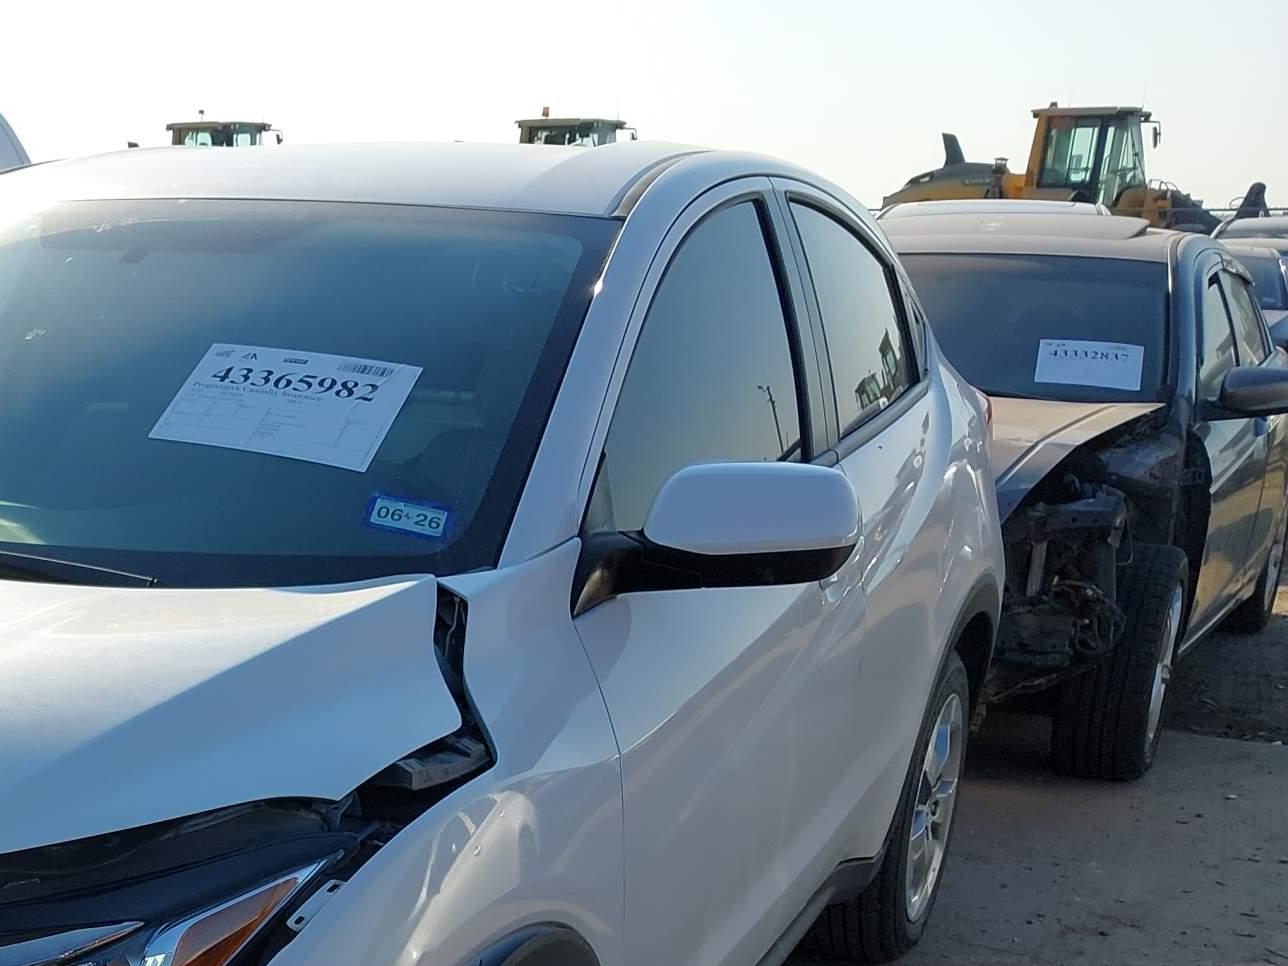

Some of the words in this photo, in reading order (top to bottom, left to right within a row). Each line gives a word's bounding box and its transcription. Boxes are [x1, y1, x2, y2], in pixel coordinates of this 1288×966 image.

[1048, 349, 1129, 361] 43332837
[212, 366, 379, 402] 43365982
[377, 506, 404, 522] 06
[414, 513, 442, 530] 26
